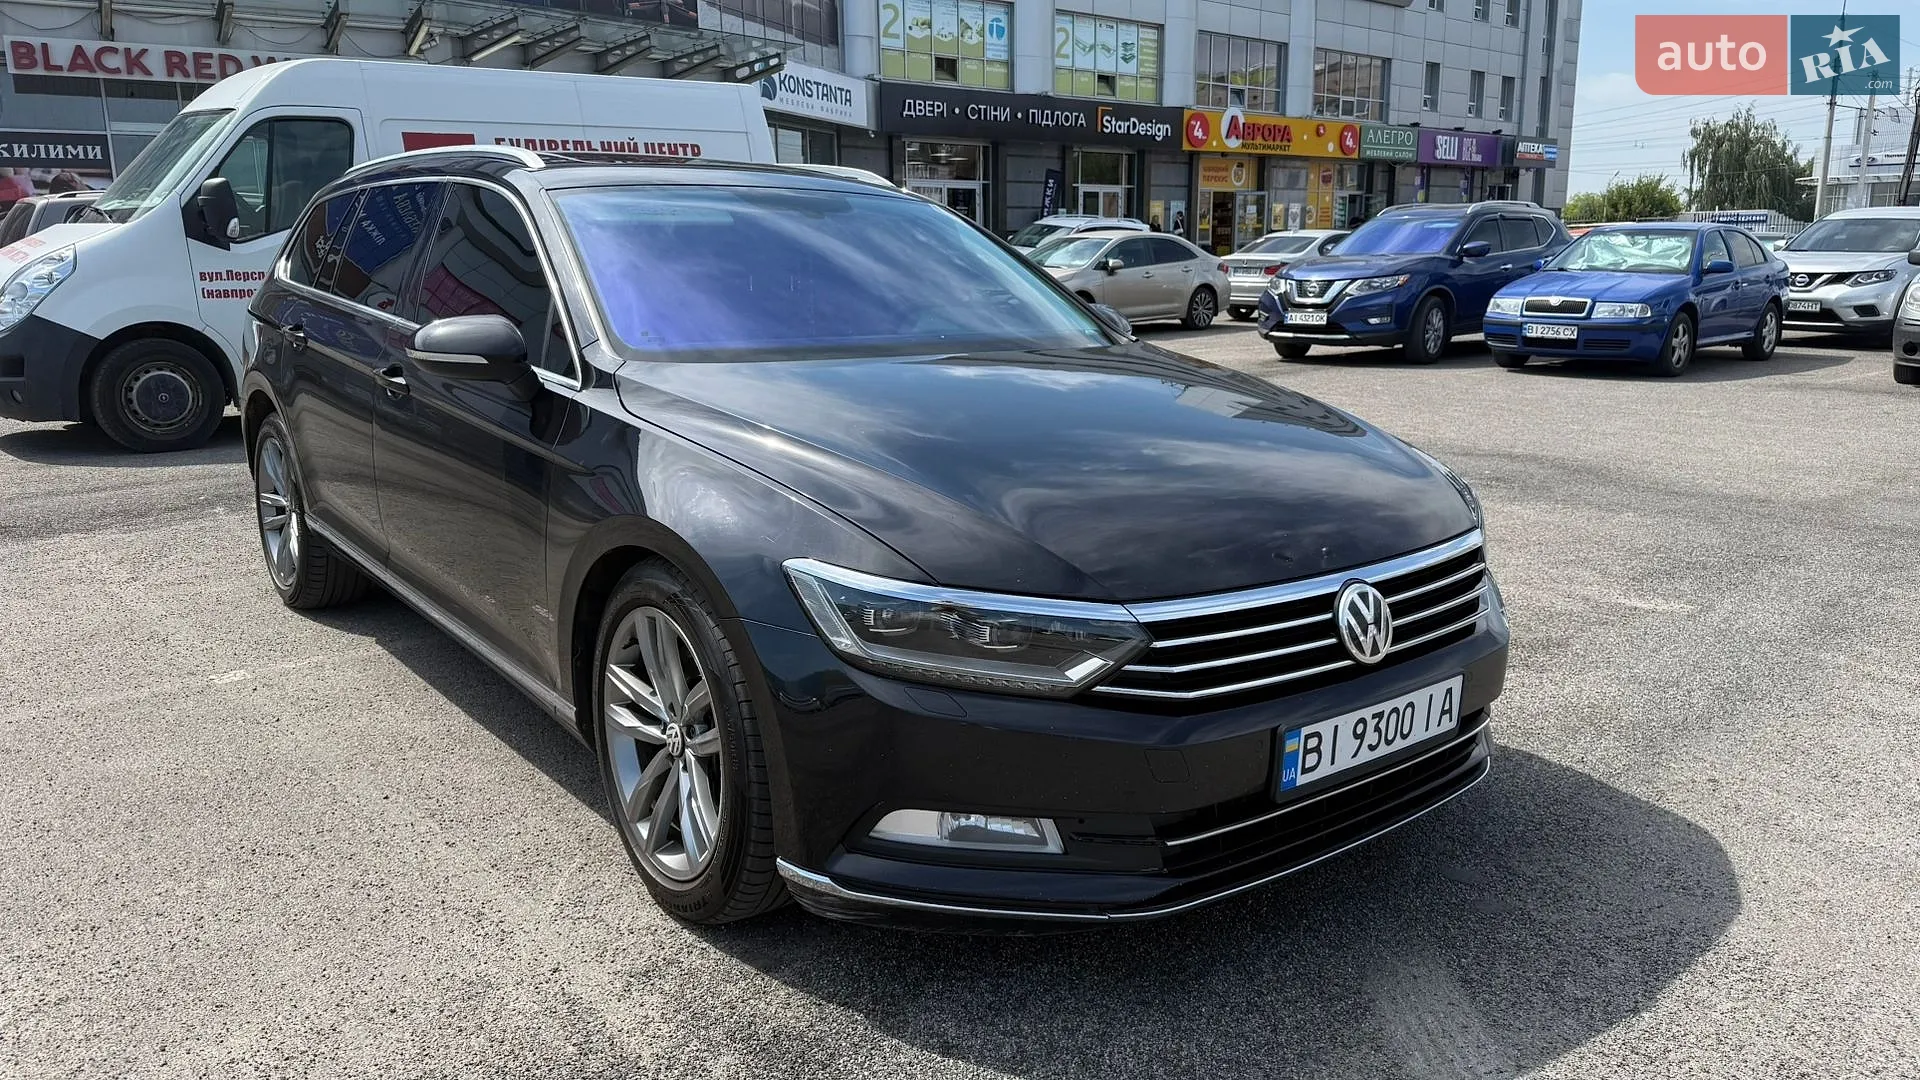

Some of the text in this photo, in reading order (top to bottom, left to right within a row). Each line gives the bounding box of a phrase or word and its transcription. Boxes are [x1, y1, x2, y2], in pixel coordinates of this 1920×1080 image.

[10, 40, 244, 80] BLACK RED
[778, 72, 852, 107] KONSTANTA
[903, 99, 1087, 128] ДВЕРІ СТІНИ ПІДЛОГА
[1102, 115, 1172, 142] StarDesign
[1366, 129, 1413, 146] АЛЕГРО
[1240, 142, 1292, 153] МУЛЬТИМАРКЕТ
[1435, 135, 1458, 160] SELLI
[1517, 142, 1544, 154] АПТЕКА
[201, 287, 257, 299] (навпро
[1300, 686, 1453, 776] BI 9300 IA
